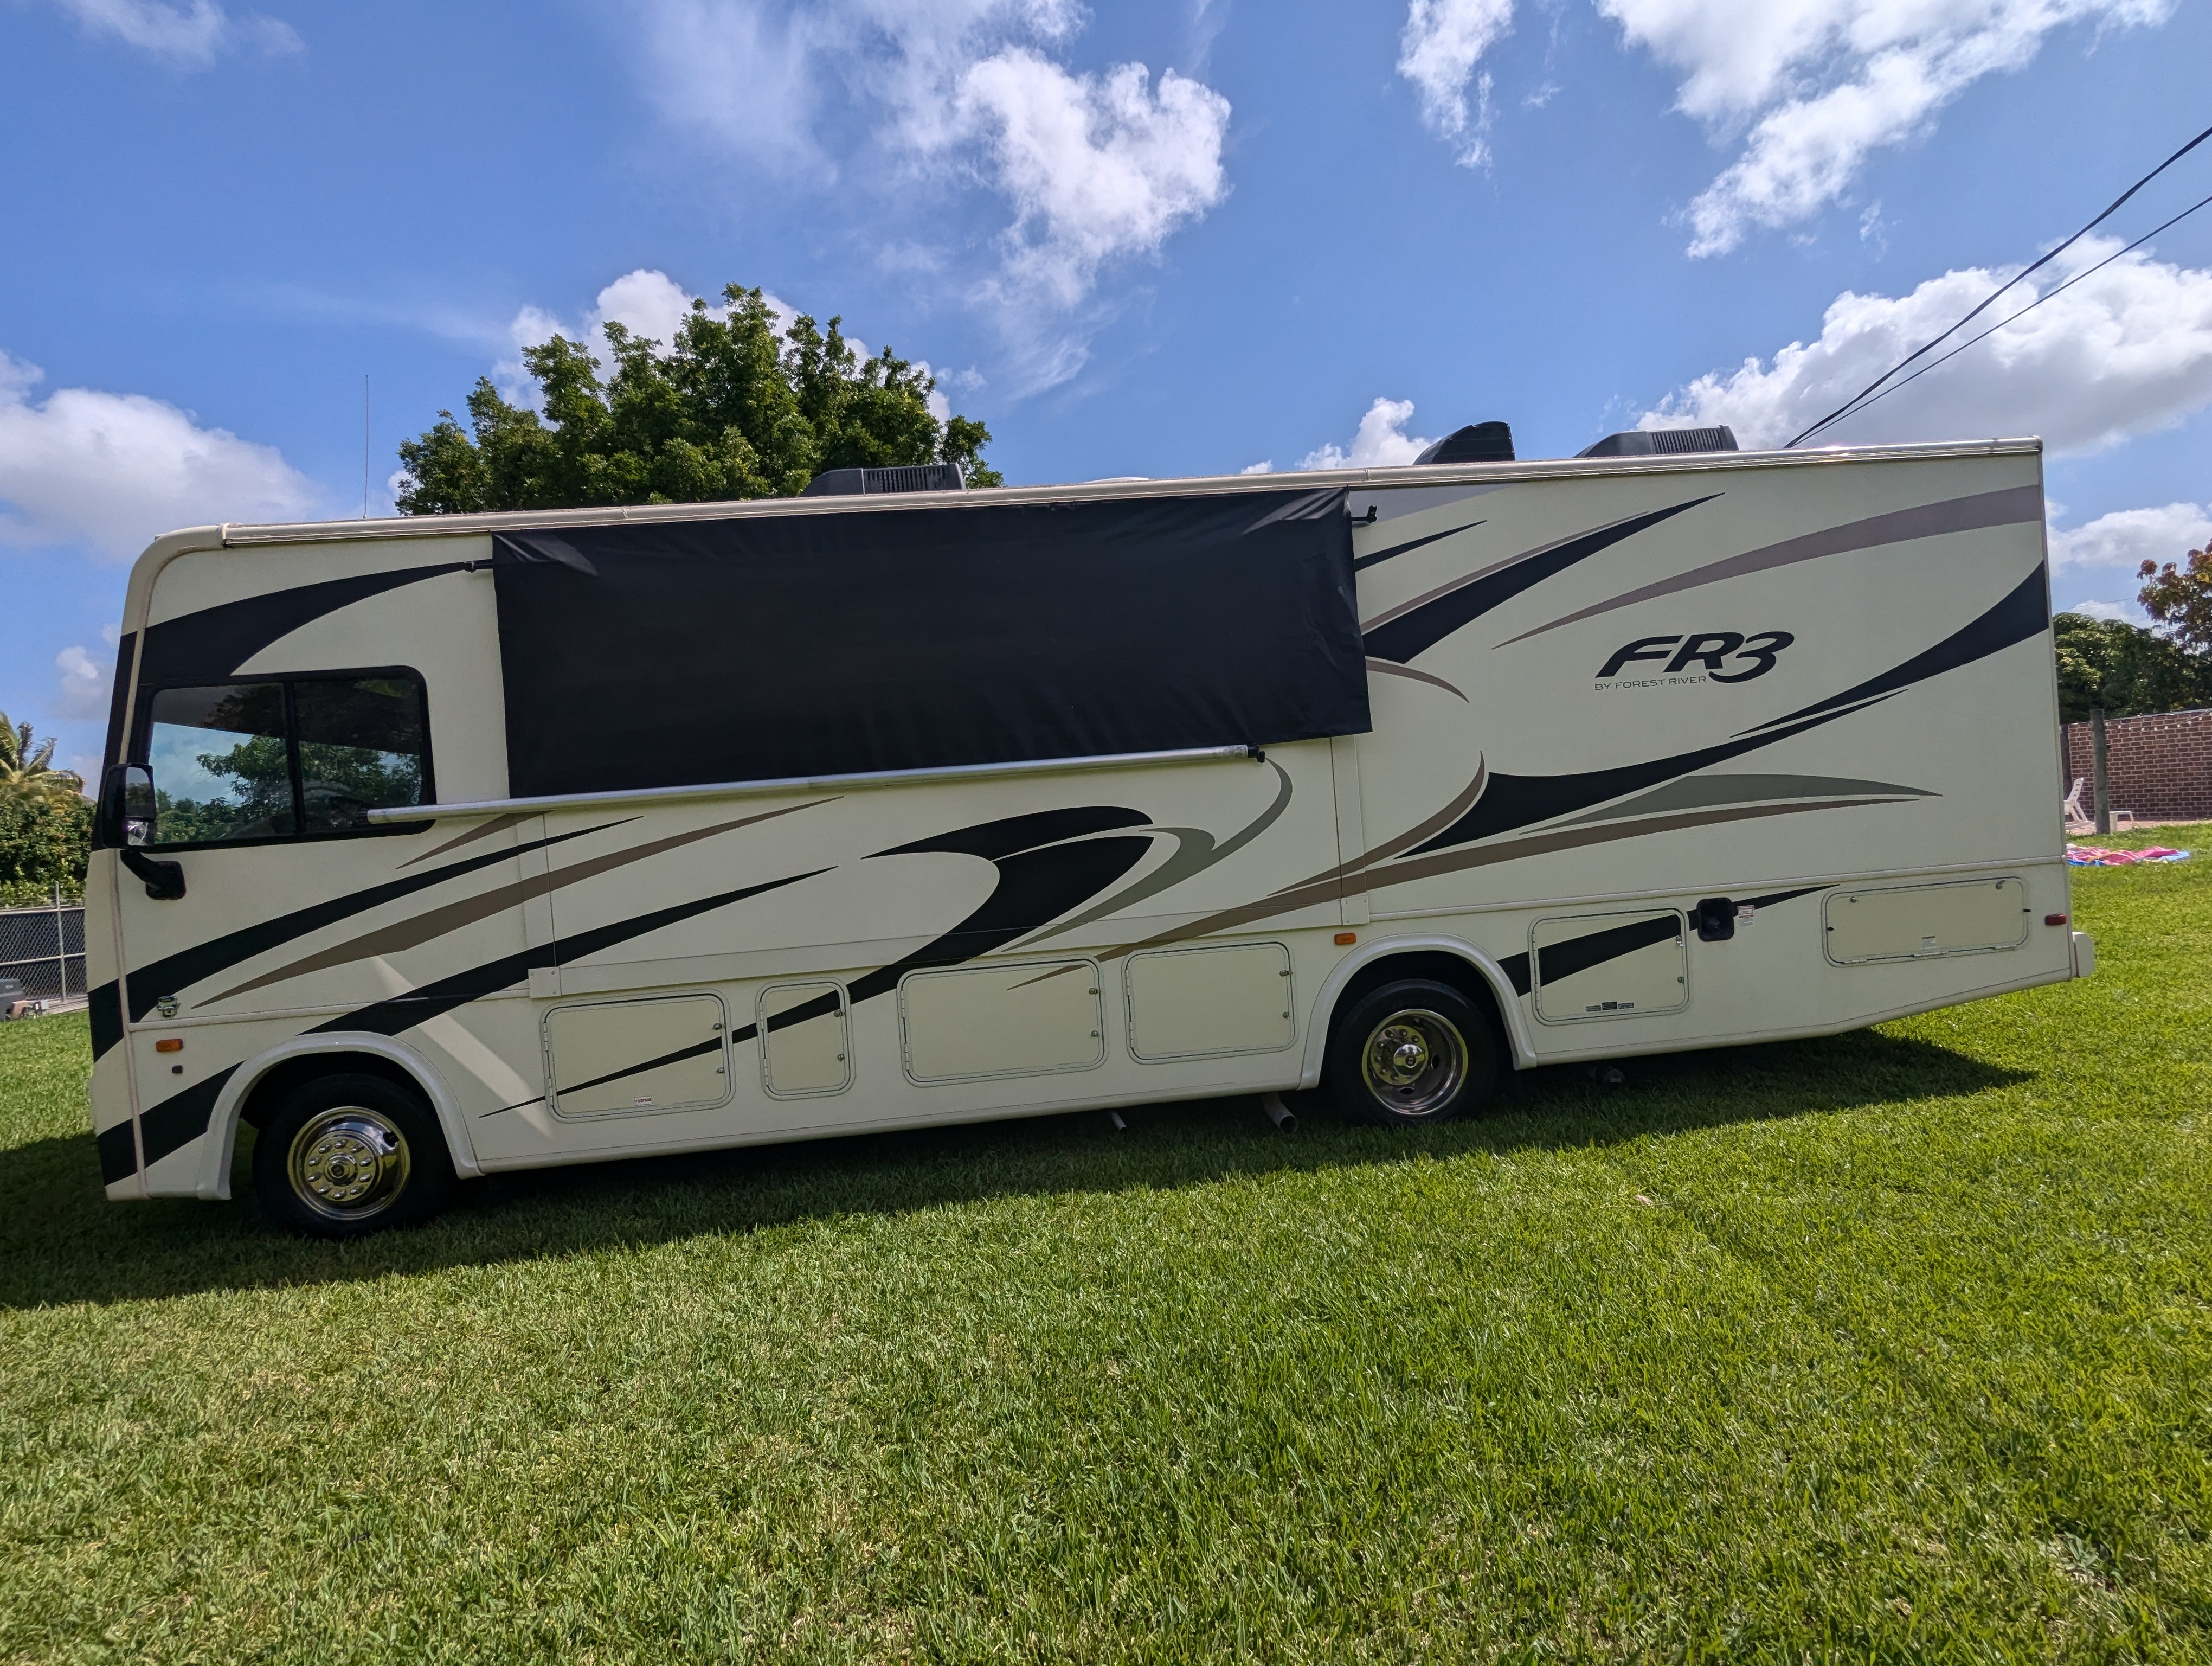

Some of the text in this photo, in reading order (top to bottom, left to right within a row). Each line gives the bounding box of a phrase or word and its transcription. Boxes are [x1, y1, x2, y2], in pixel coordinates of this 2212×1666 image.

[1595, 631, 1795, 683] FR3
[1594, 676, 1707, 691] BY FOREST RIVER
